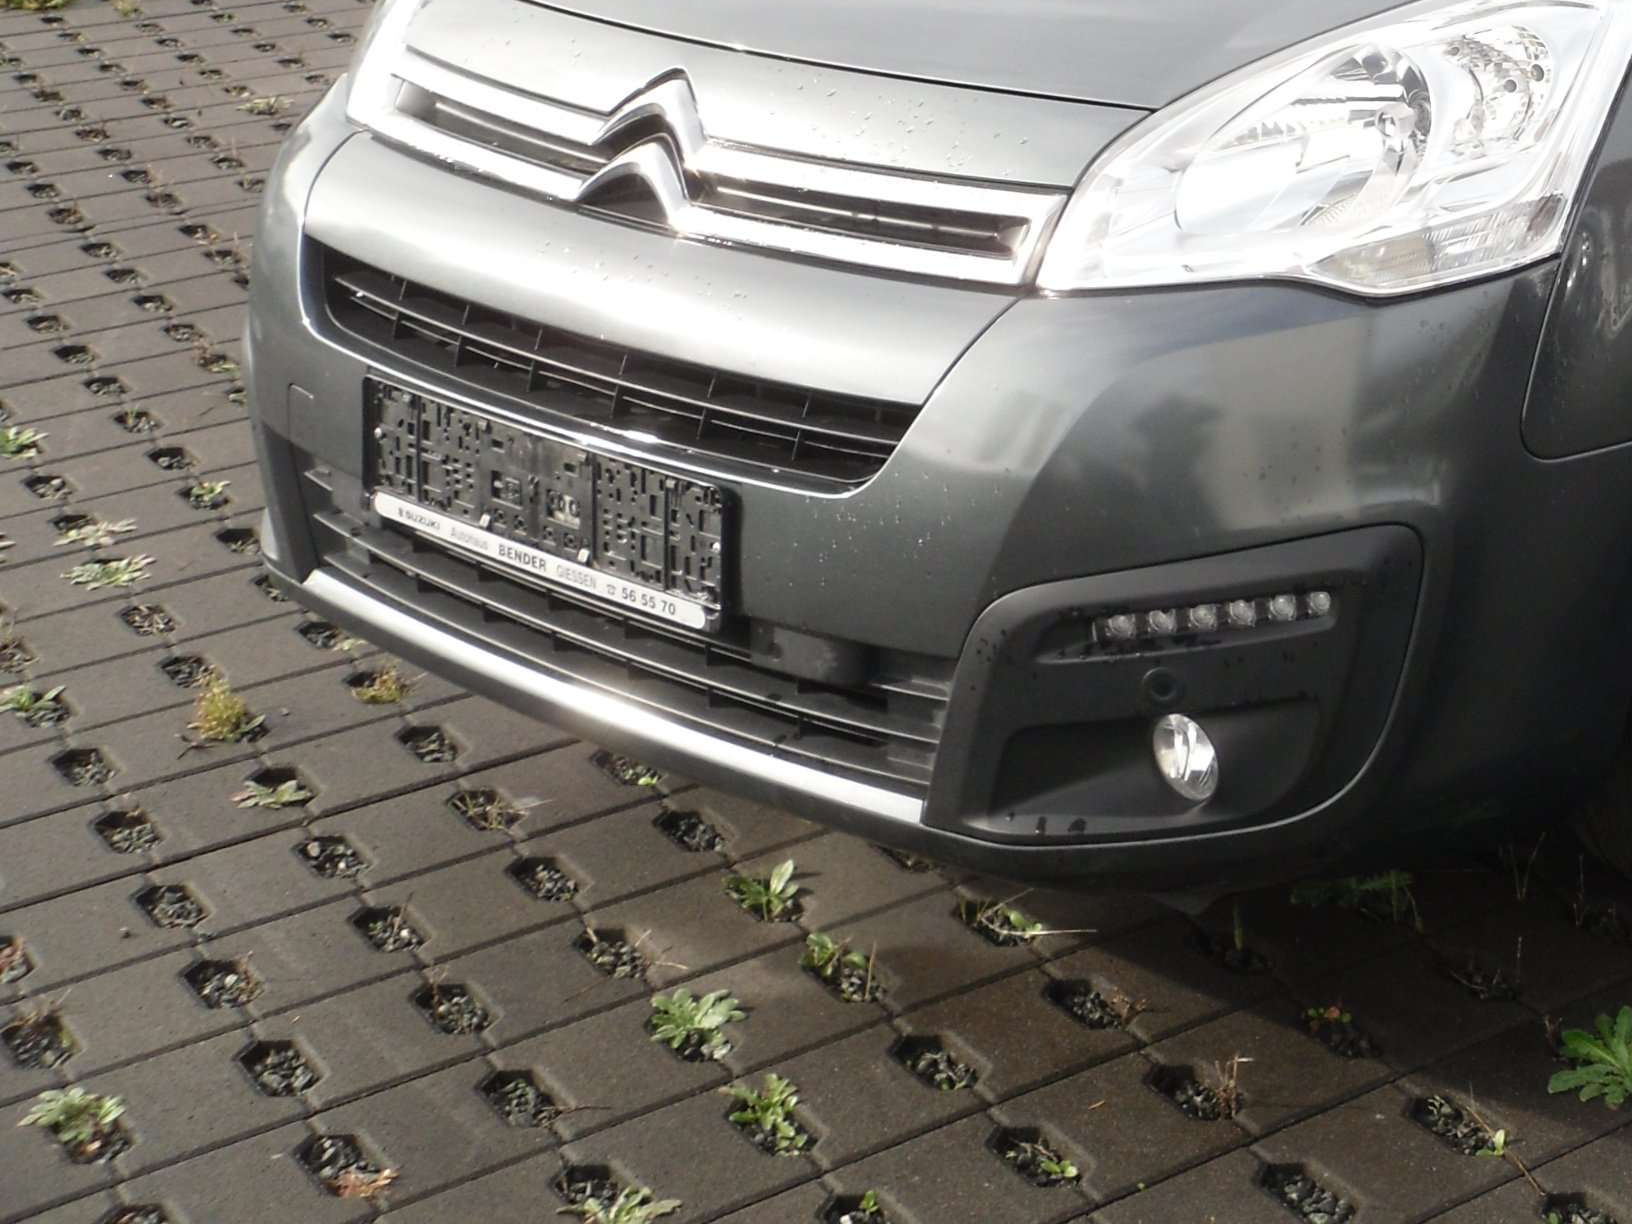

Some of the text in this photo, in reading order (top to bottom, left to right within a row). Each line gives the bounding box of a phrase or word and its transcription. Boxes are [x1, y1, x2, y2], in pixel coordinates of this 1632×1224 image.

[406, 511, 441, 530] SUZUKI
[498, 544, 547, 572] BENDER
[556, 565, 597, 589] GIESSEN
[621, 587, 637, 603] 56
[641, 593, 656, 609] 55
[661, 600, 676, 616] 70
